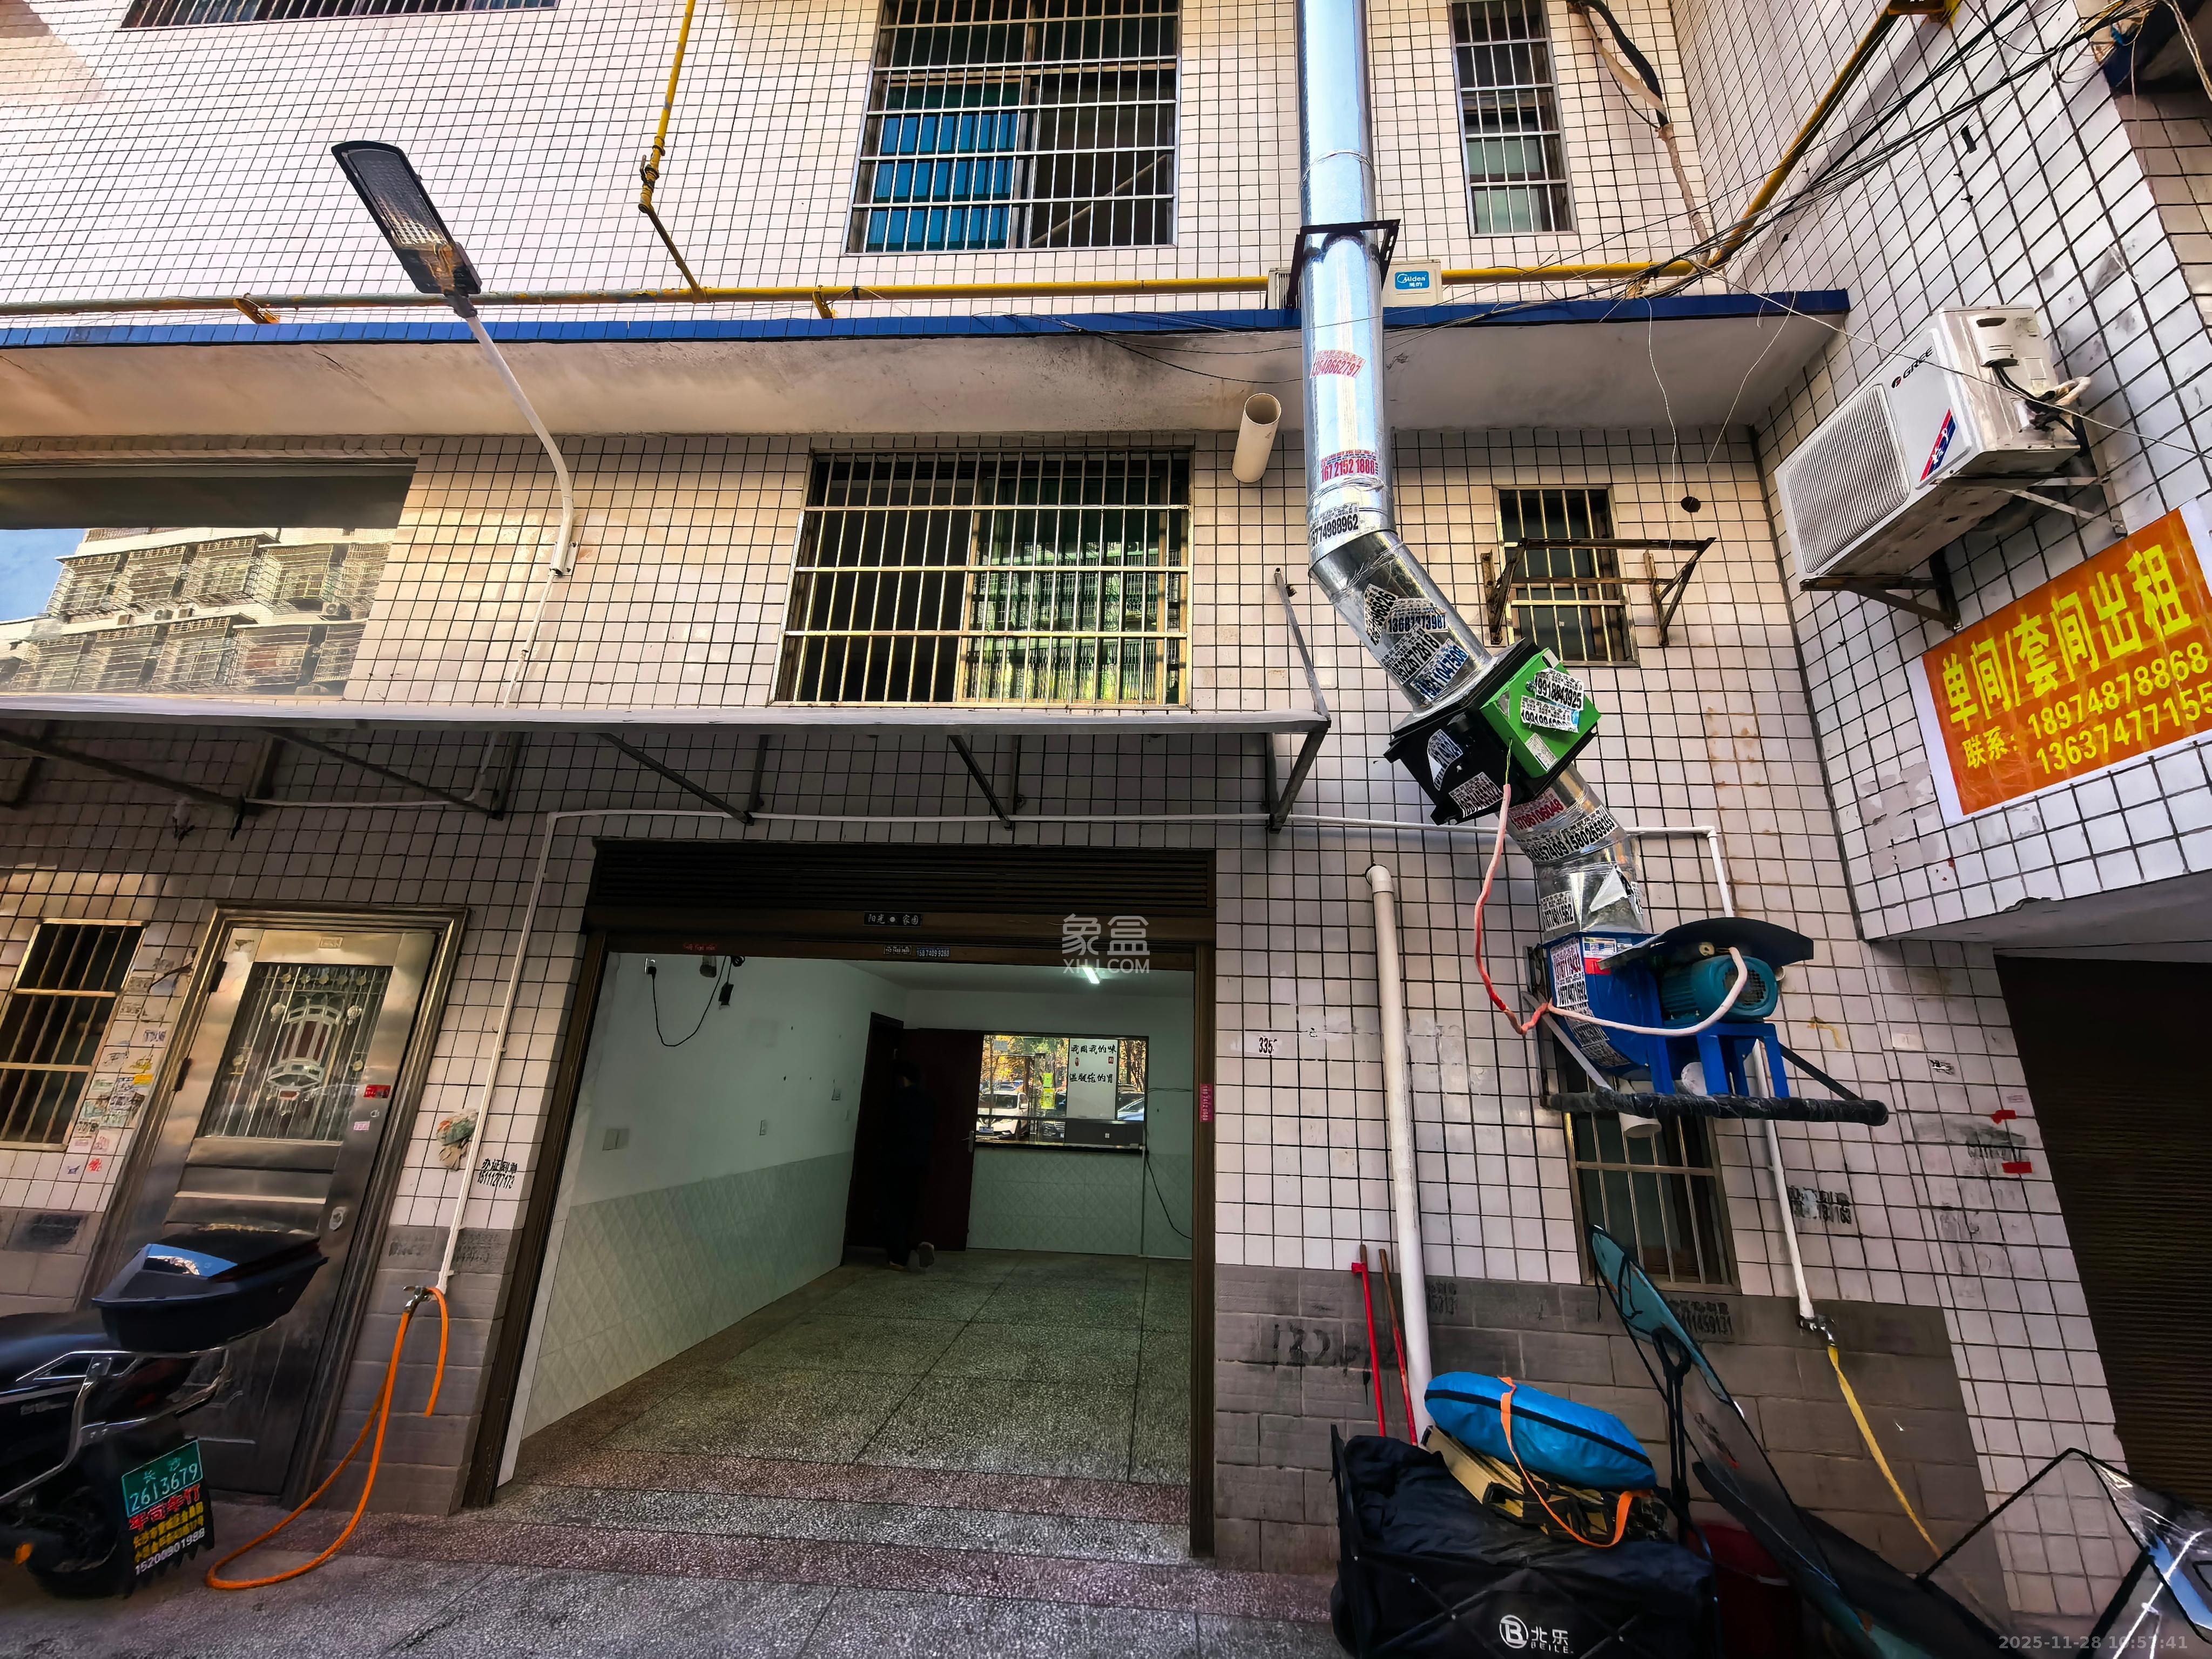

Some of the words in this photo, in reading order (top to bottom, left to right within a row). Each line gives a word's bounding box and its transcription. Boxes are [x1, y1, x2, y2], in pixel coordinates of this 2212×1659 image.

[1903, 346, 1933, 379] GREE
[1334, 458, 1354, 477] 2152
[1943, 544, 2191, 731] 单间/套间出租
[2028, 642, 2208, 739] 18974878868
[2036, 682, 2212, 774] 13637477155
[129, 1462, 199, 1512] 2613679
[1530, 1626, 1569, 1646] 北乐
